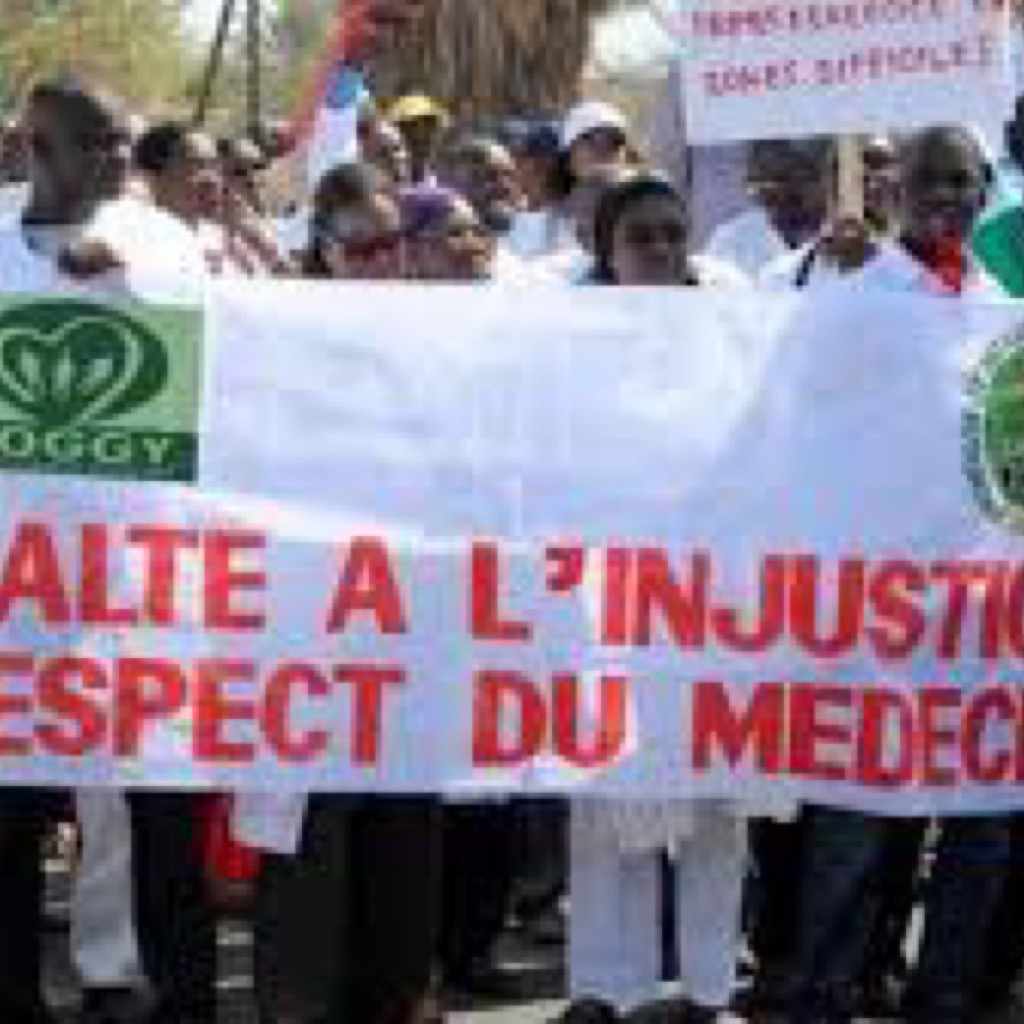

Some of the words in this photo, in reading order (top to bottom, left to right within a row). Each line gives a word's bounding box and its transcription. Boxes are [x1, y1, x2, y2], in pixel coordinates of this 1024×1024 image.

[0, 521, 265, 631] ALTE
[327, 537, 405, 634] A
[470, 542, 1024, 661] L'INJUSTI
[0, 653, 404, 768] ESPECT
[471, 668, 627, 769] DU
